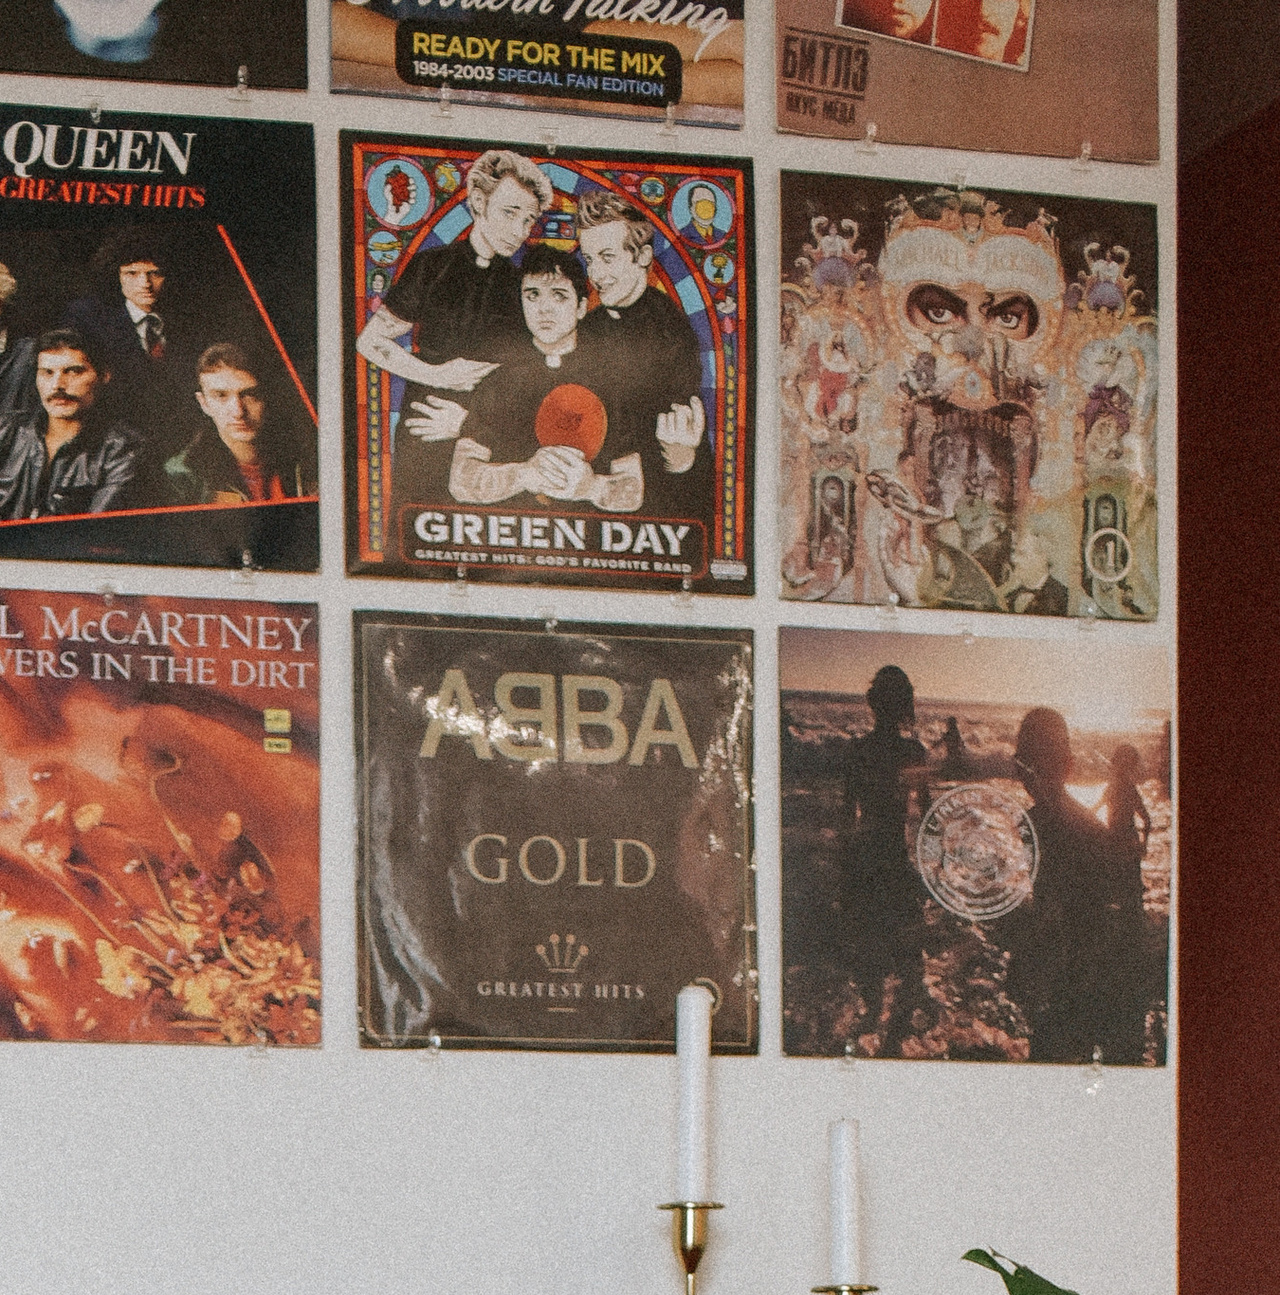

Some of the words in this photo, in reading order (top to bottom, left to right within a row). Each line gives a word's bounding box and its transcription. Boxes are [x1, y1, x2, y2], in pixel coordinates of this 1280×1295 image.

[412, 32, 501, 61] READY
[506, 41, 560, 67] FOR
[566, 45, 616, 72] THE
[621, 51, 666, 77] MIX
[782, 35, 869, 92] БИТЛЗ
[413, 60, 495, 81] 1984-2003
[497, 68, 562, 86] SPECIAL
[567, 73, 599, 90] FAN
[602, 78, 664, 96] EDITION
[3, 121, 197, 178] QUEEN
[140, 184, 206, 209] HITS
[414, 511, 586, 550] GREEN
[601, 520, 690, 556] DAY
[415, 549, 487, 563] GREATEST
[535, 555, 579, 568] GOD'S
[583, 558, 650, 572] FAVORITE
[653, 562, 692, 574] BAND
[41, 606, 312, 653] McCARTNEY
[91, 652, 131, 681] IN
[141, 655, 218, 686] THE
[231, 660, 318, 689] DIRT
[420, 669, 700, 769] ABBA
[466, 833, 657, 889] GOLD
[477, 981, 584, 998] GREATEST
[594, 984, 646, 1000] HITS
